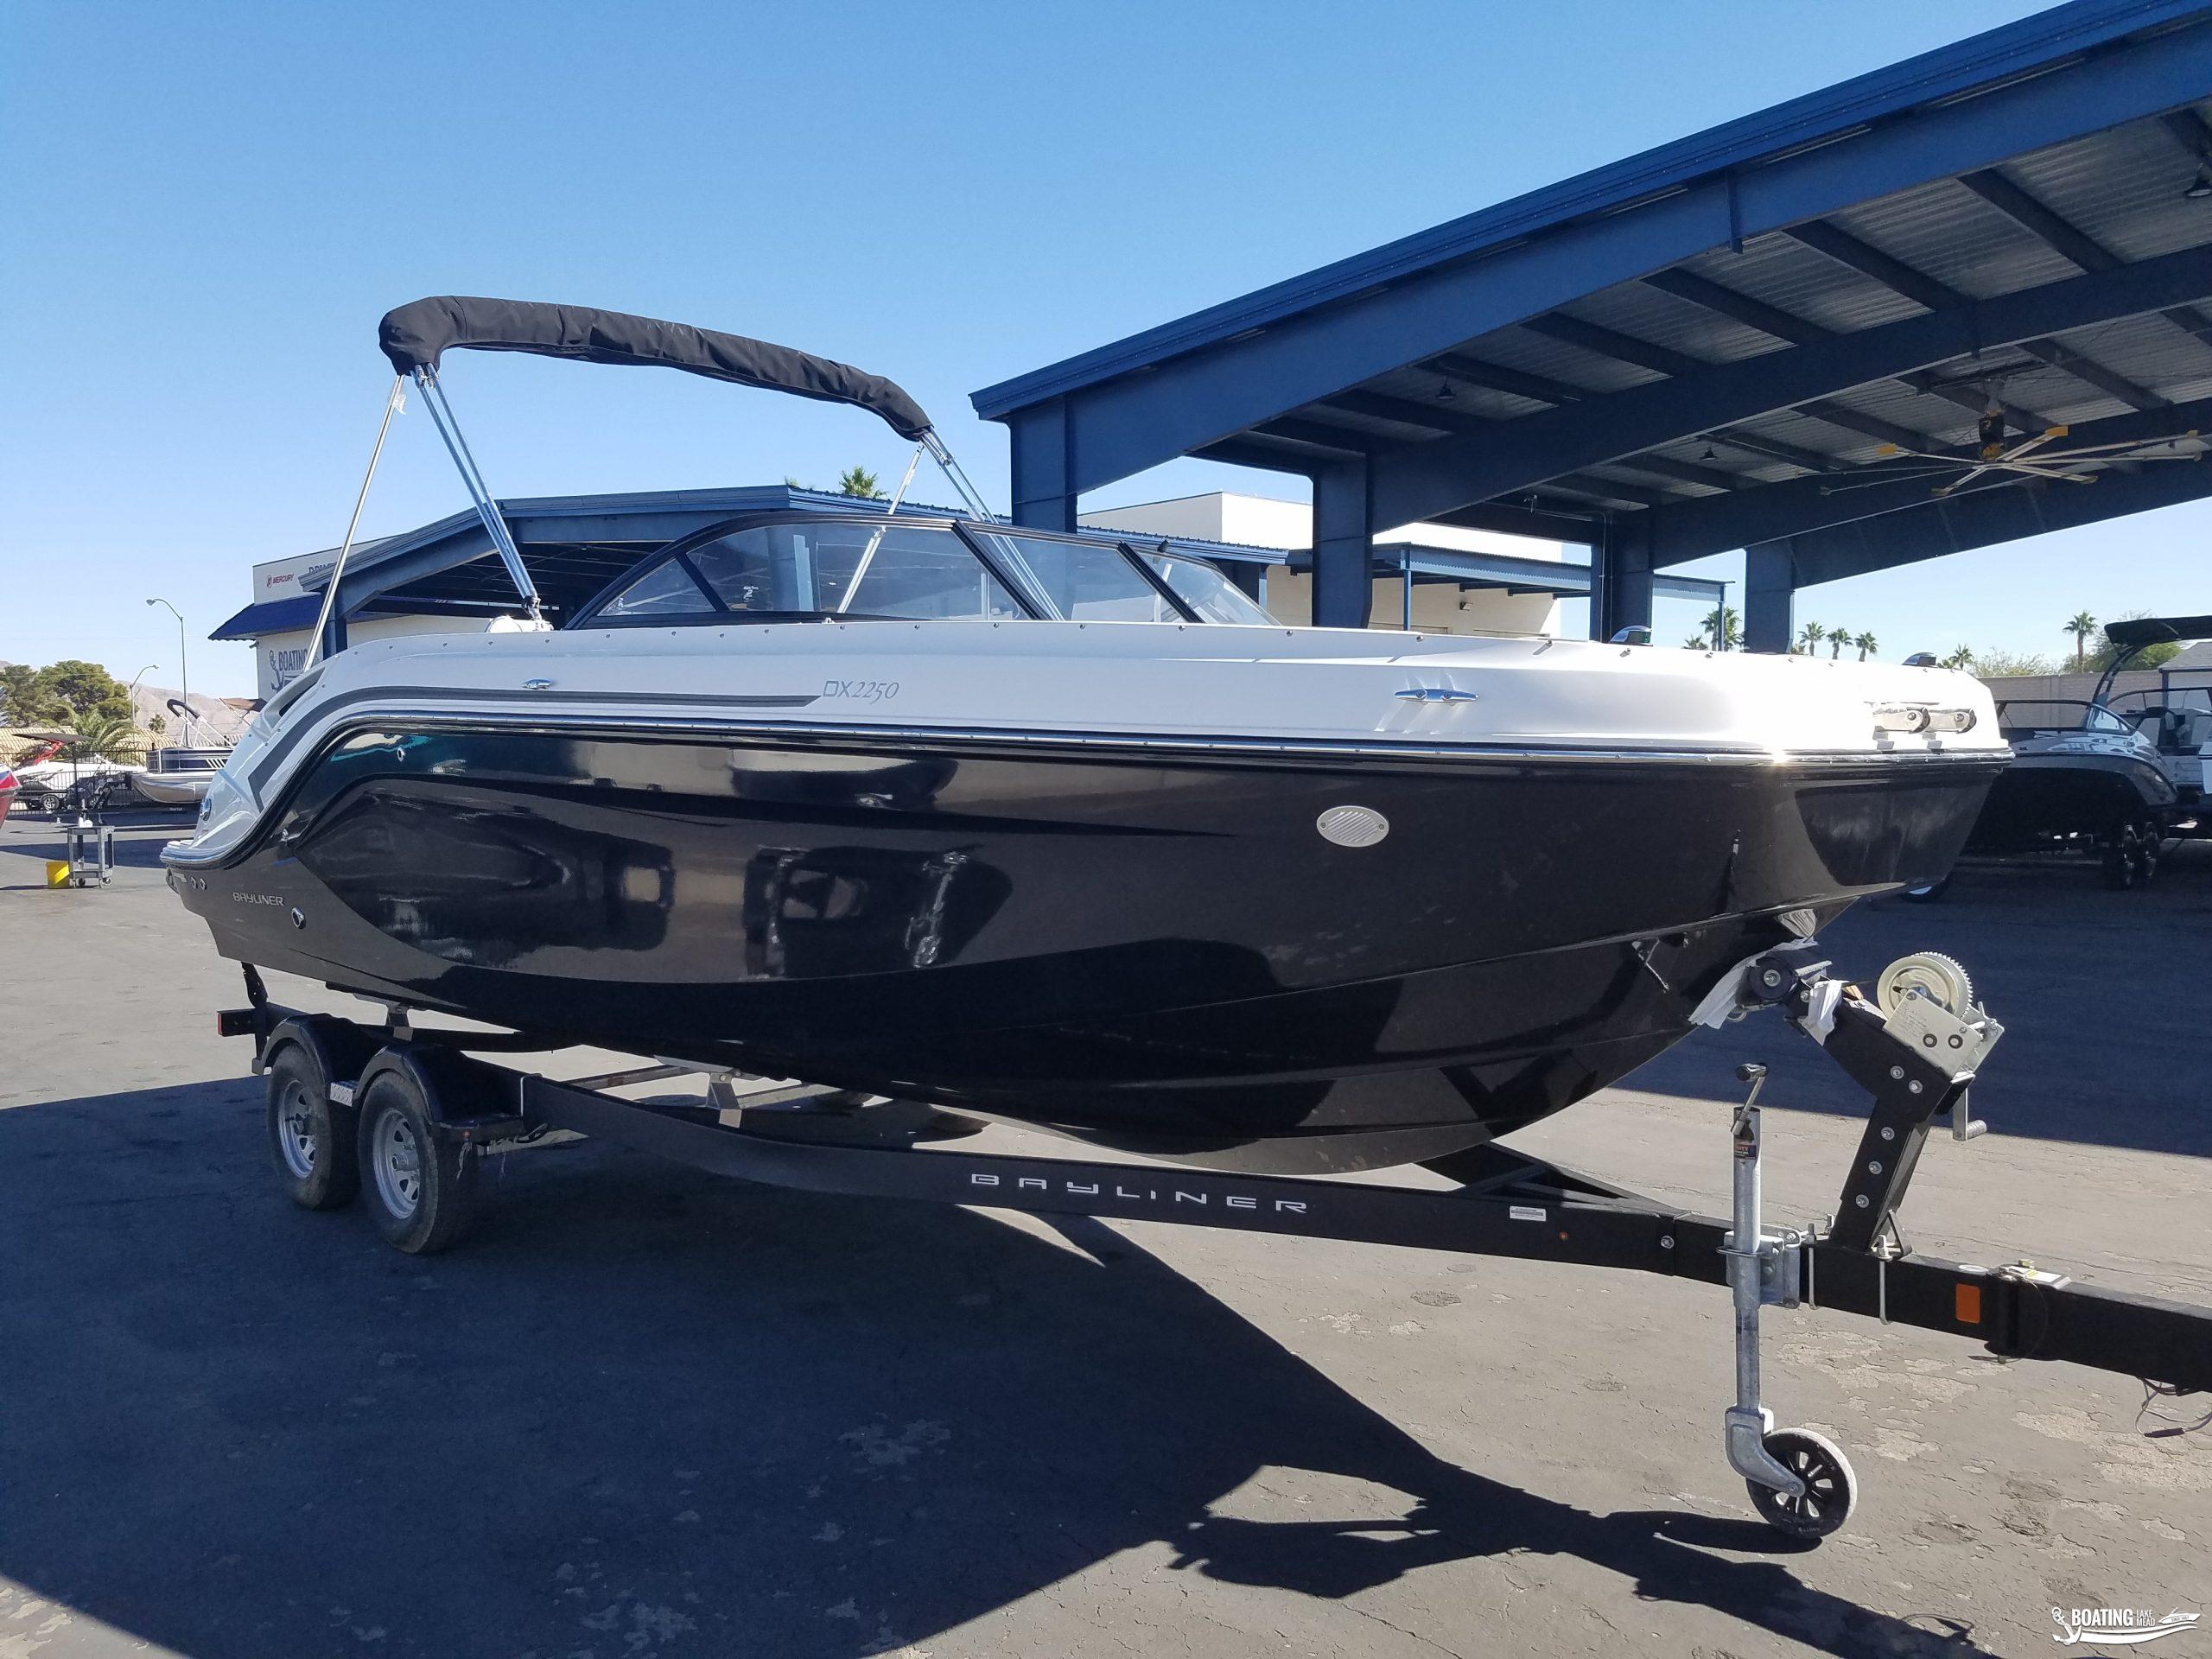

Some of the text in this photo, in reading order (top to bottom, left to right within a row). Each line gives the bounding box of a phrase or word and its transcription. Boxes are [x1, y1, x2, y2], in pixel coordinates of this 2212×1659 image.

[272, 574, 295, 584] MERCURY
[823, 680, 900, 705] DX2250
[232, 892, 285, 906] BAYLINER
[971, 1173, 1307, 1214] BAYLINER
